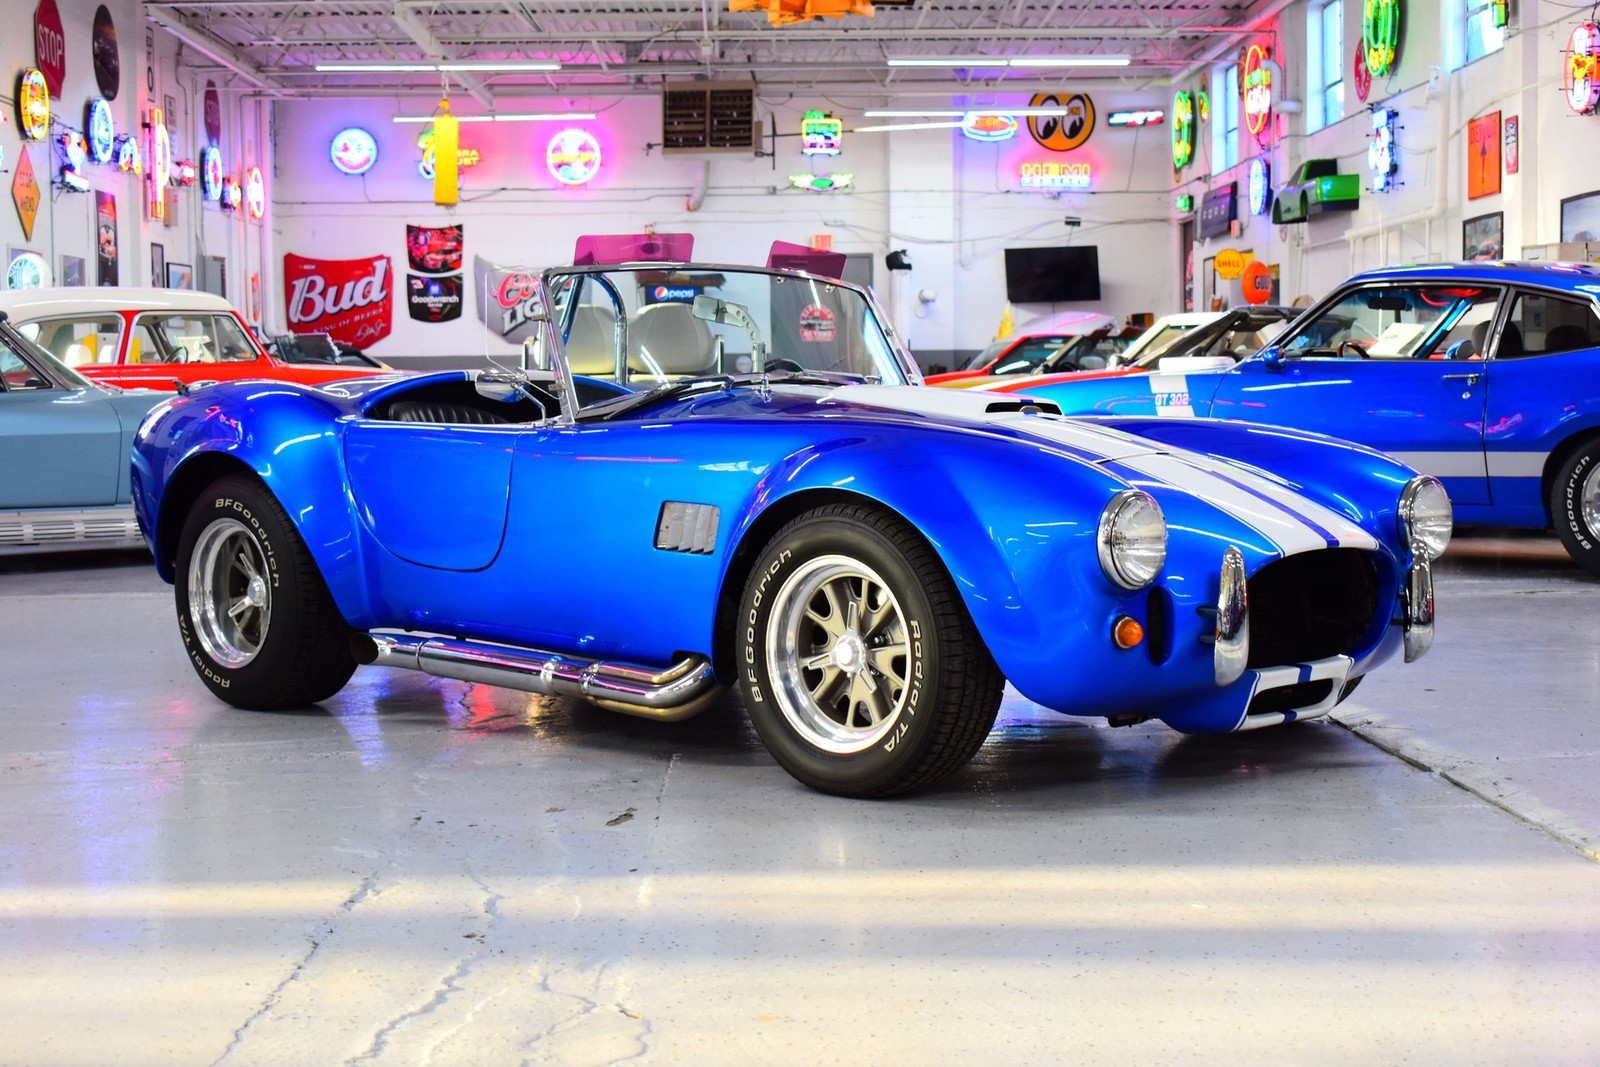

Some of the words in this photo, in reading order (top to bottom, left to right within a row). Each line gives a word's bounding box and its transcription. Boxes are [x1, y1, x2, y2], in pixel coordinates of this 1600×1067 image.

[39, 24, 63, 69] STOP
[1021, 163, 1090, 177] HEMI
[289, 259, 387, 324] Bud
[412, 295, 460, 303] Goodwrench
[669, 289, 694, 299] pepsi
[1155, 393, 1168, 406] GT
[1169, 393, 1189, 405] 302
[1566, 455, 1592, 550] BFGoodrich
[215, 498, 280, 588] BFGoodrich
[180, 614, 192, 646] T/A
[745, 549, 792, 702] BFGoodrich
[191, 650, 231, 688] Radial
[910, 620, 924, 715] Radial
[884, 721, 909, 752] T/A
